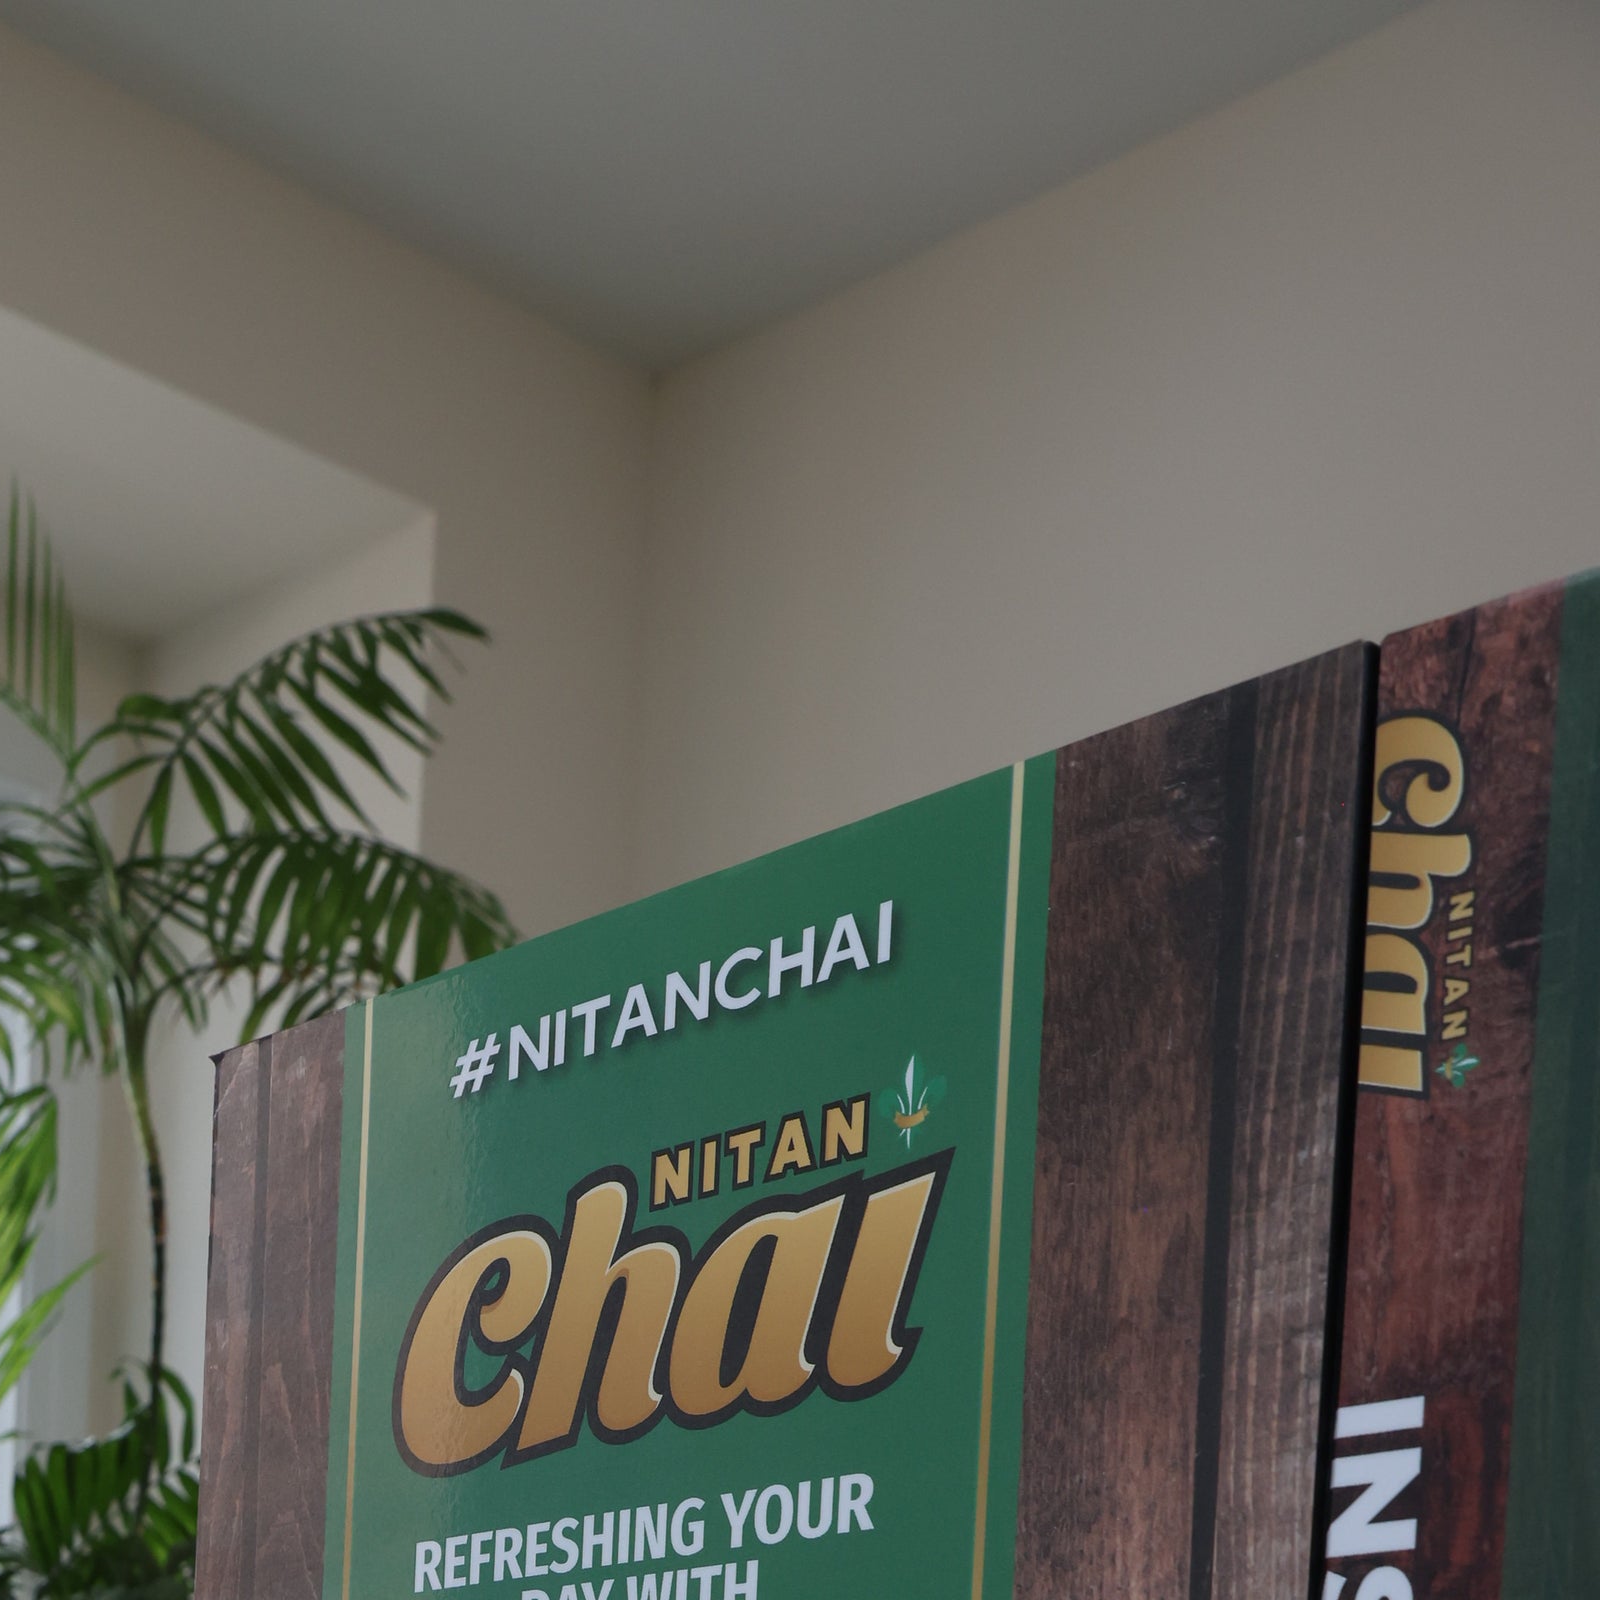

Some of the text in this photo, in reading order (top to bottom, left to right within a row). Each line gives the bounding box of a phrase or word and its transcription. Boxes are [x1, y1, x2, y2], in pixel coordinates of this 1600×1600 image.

[450, 900, 895, 1098] #NITANCHAI
[1443, 890, 1475, 1042] NITAN
[650, 1092, 870, 1211] NITAN
[413, 1472, 875, 1594] REFRESHING YOUR
